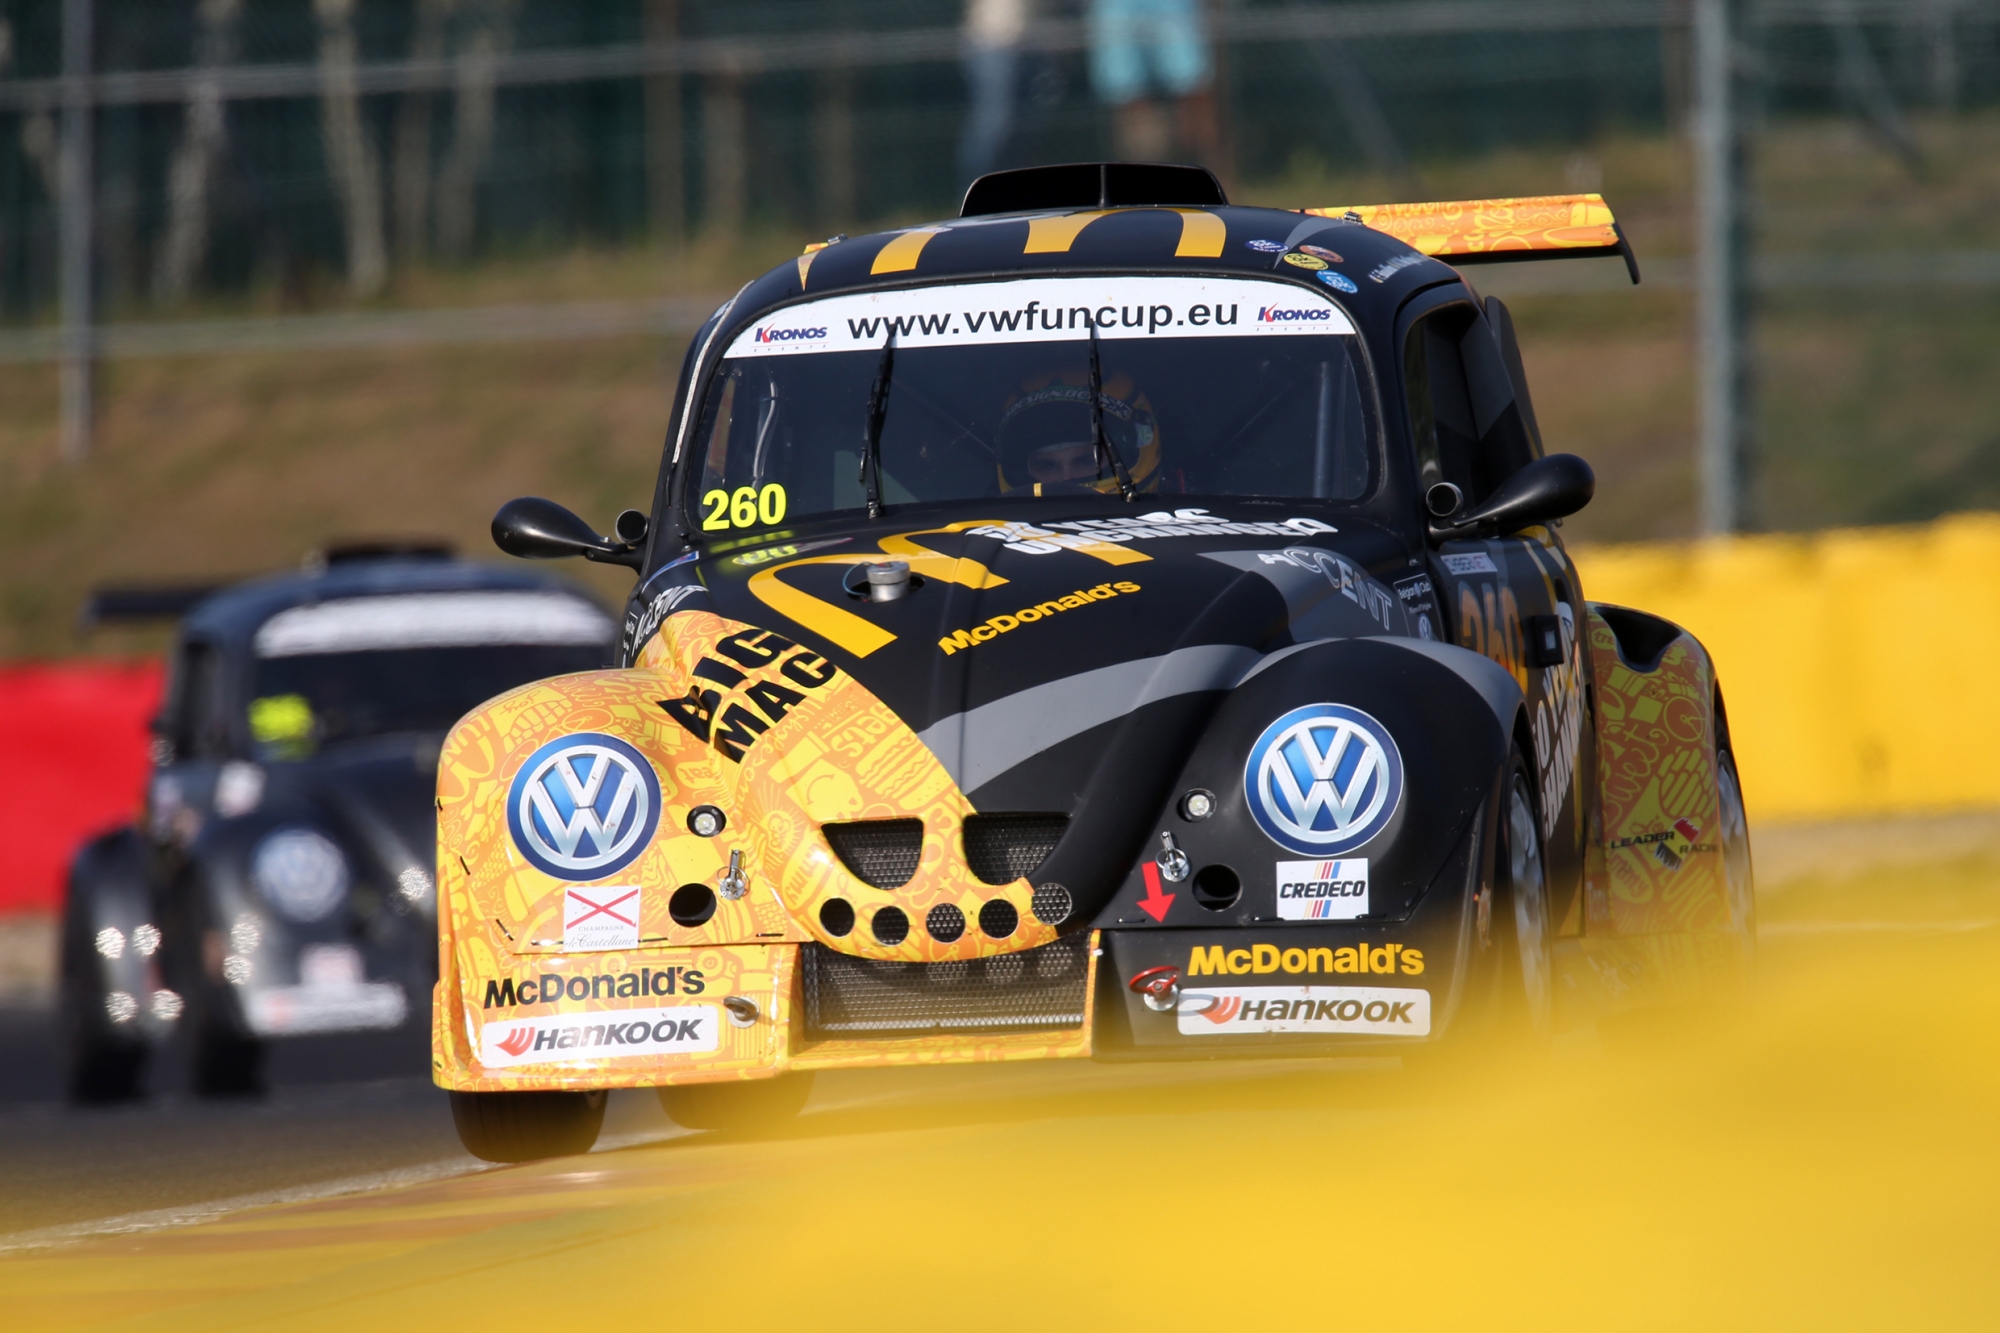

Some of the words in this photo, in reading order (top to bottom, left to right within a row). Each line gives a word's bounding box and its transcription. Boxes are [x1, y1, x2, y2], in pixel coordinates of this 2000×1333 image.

[847, 301, 1239, 339] www.vwfuncup.eu
[1257, 302, 1331, 322] KRONOS
[755, 322, 828, 343] KRONOS
[702, 483, 787, 531] 260
[1003, 518, 1338, 555] UNCHANGED
[1257, 549, 1392, 631] ACCENT
[938, 580, 1141, 655] McDonald's
[656, 628, 796, 748] BIG
[714, 652, 837, 765] MAC
[1611, 831, 1674, 849] LEADER
[1279, 880, 1366, 899] CREDECO
[577, 933, 635, 949] Castellane
[1187, 943, 1425, 976] McDonald's
[484, 966, 706, 1010] McDonald's
